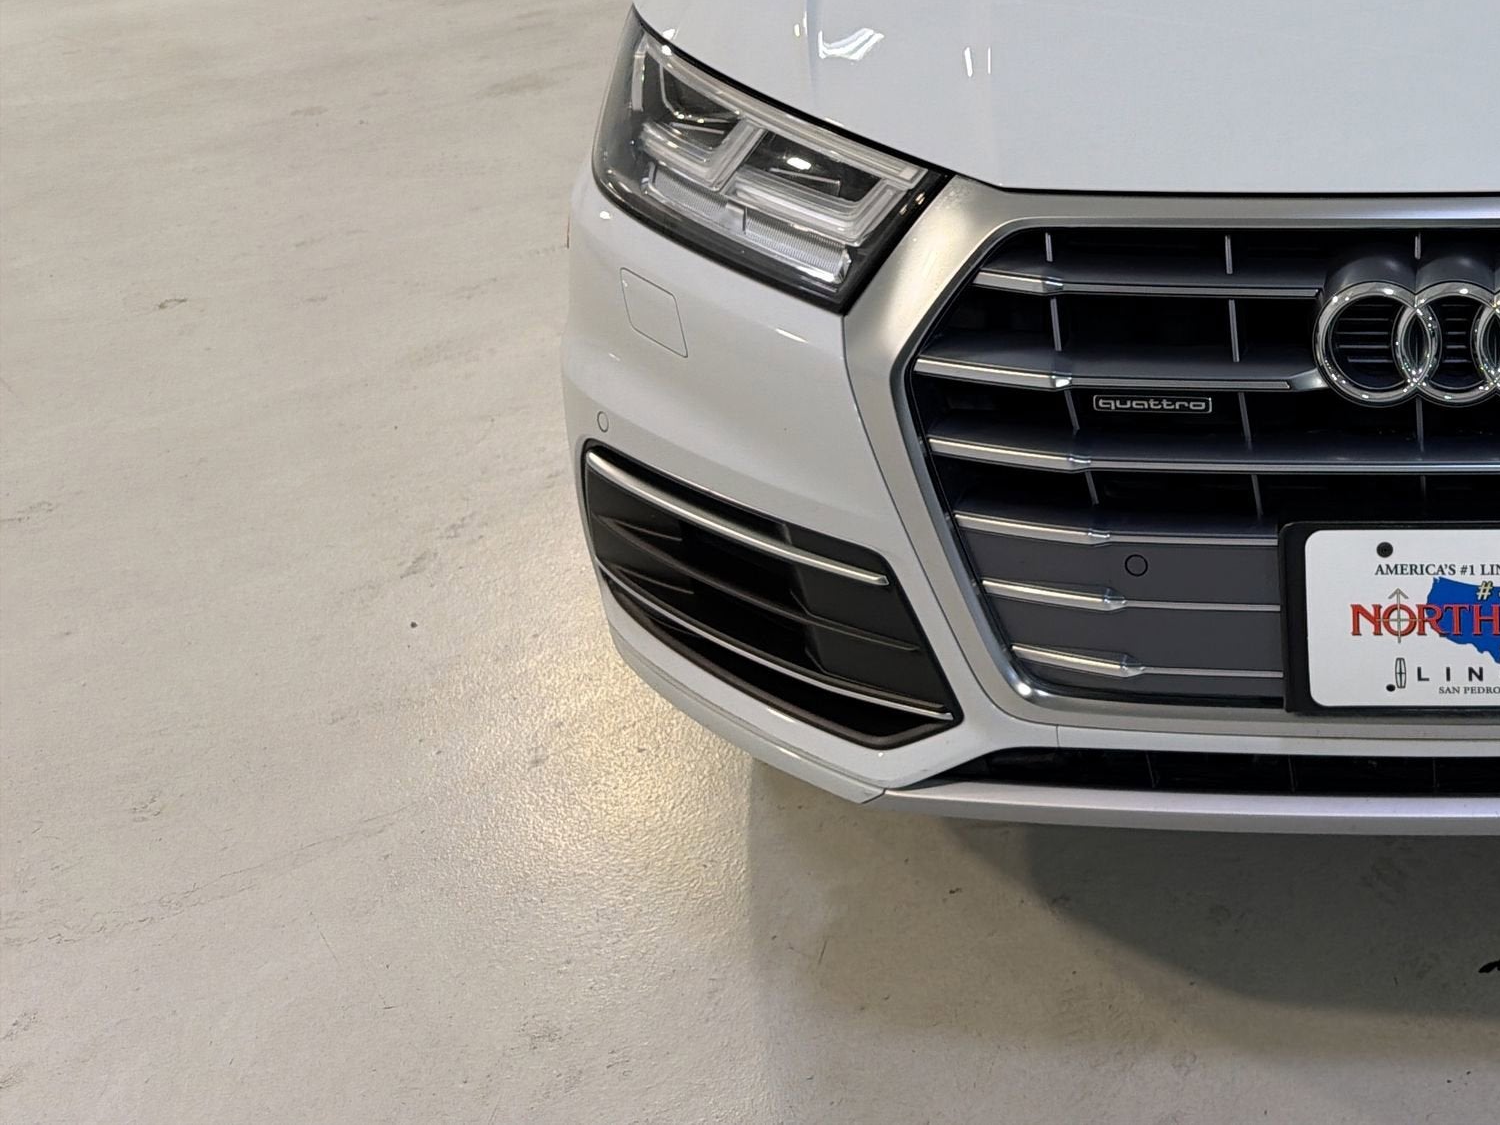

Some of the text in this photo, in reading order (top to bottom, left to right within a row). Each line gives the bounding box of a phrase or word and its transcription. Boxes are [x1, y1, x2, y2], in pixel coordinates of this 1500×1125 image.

[1098, 398, 1206, 410] quattro
[1374, 563, 1457, 576] AMERICA'S
[1460, 564, 1476, 576] #1
[1438, 686, 1460, 695] SAN
[1463, 686, 1500, 695] PEDRO
